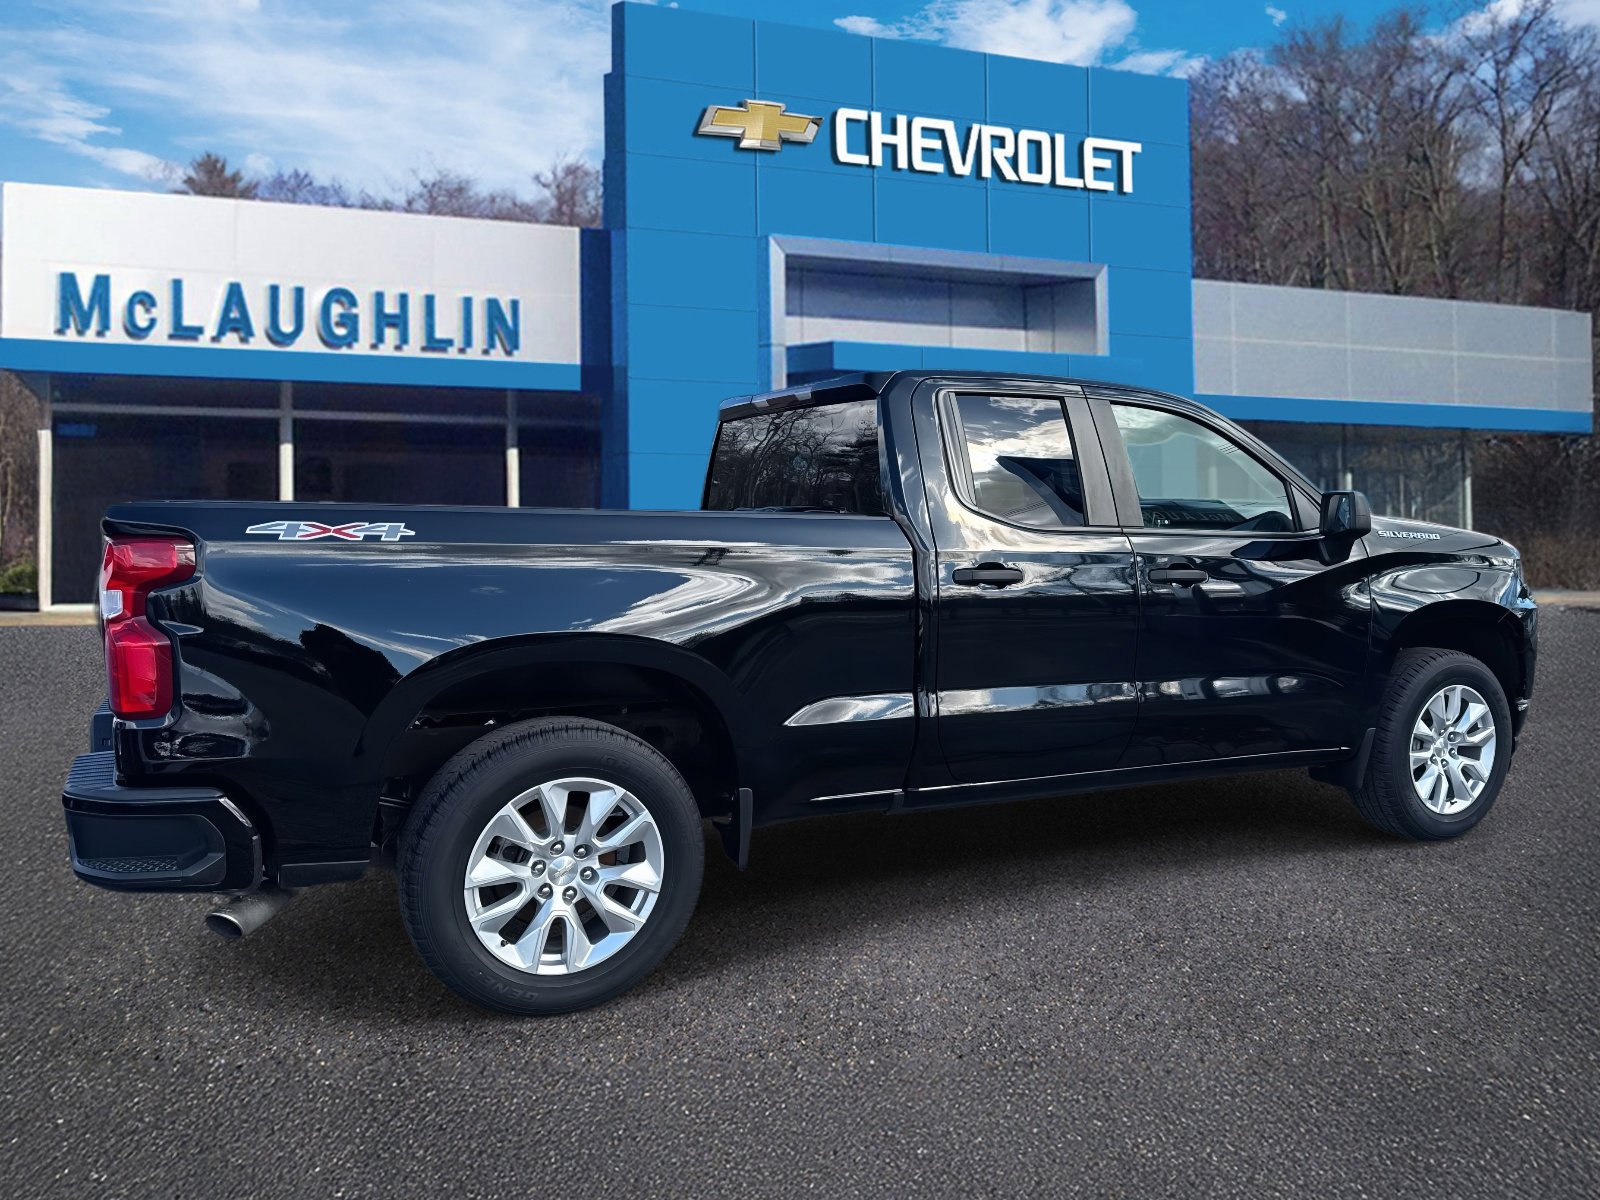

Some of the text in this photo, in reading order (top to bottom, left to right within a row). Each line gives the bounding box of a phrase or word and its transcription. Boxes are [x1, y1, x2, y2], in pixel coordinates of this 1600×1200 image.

[833, 107, 1142, 193] CHEVROLET
[53, 271, 521, 357] McLAUGHLIN
[1377, 529, 1441, 541] SILVERADO
